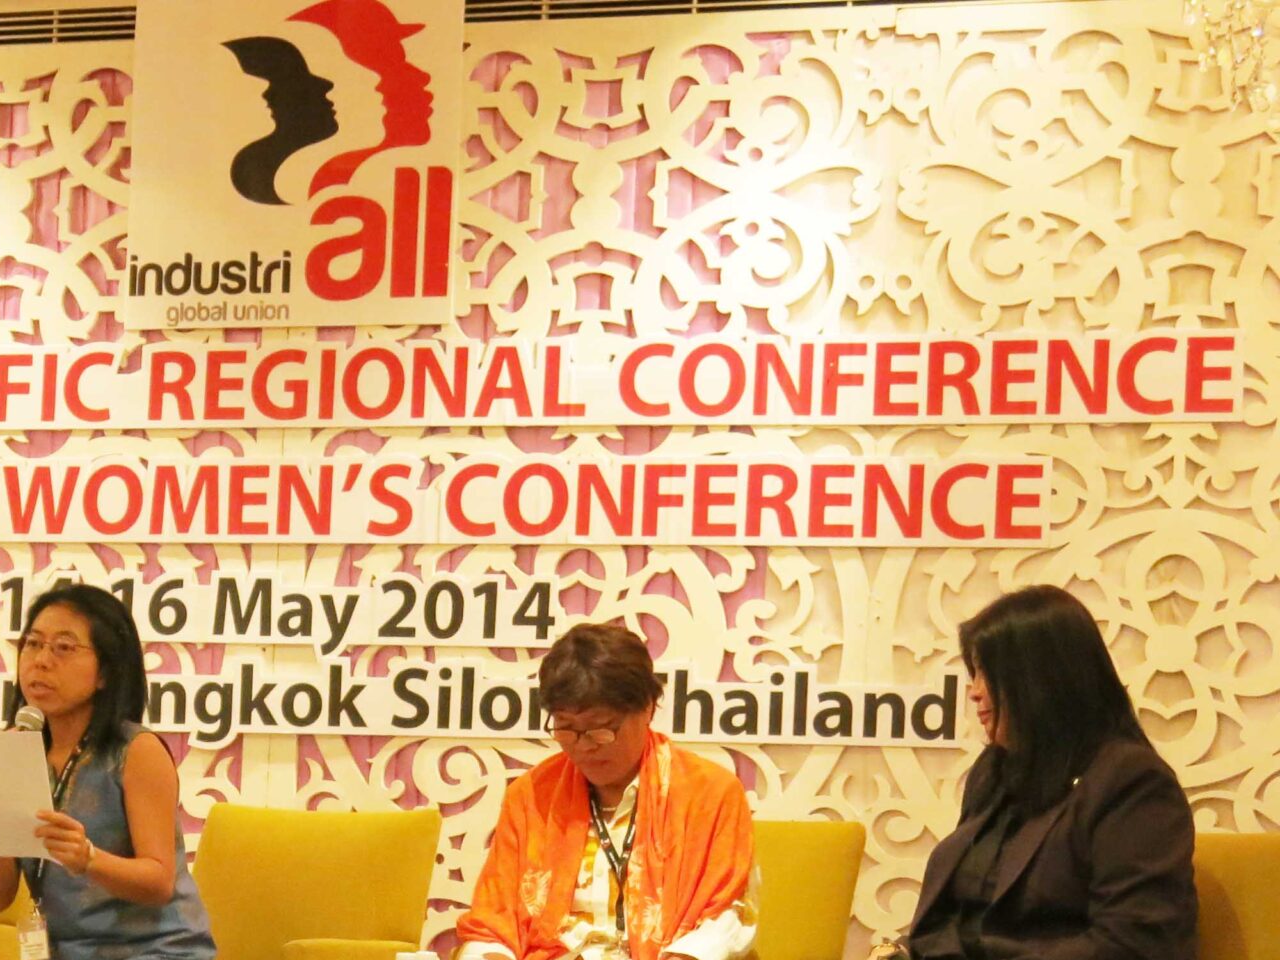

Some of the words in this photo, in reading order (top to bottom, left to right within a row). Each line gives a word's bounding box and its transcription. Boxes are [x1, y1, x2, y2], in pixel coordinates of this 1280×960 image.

[166, 300, 228, 327] global
[233, 300, 290, 322] union
[147, 346, 587, 422] REGIONAL
[618, 336, 1237, 418] CONFERENCE
[4, 462, 414, 538] WOMEN’S
[445, 462, 1045, 541] CONFERENCE
[212, 577, 360, 656] May
[378, 579, 556, 641] 2014
[146, 663, 367, 743] ngkok
